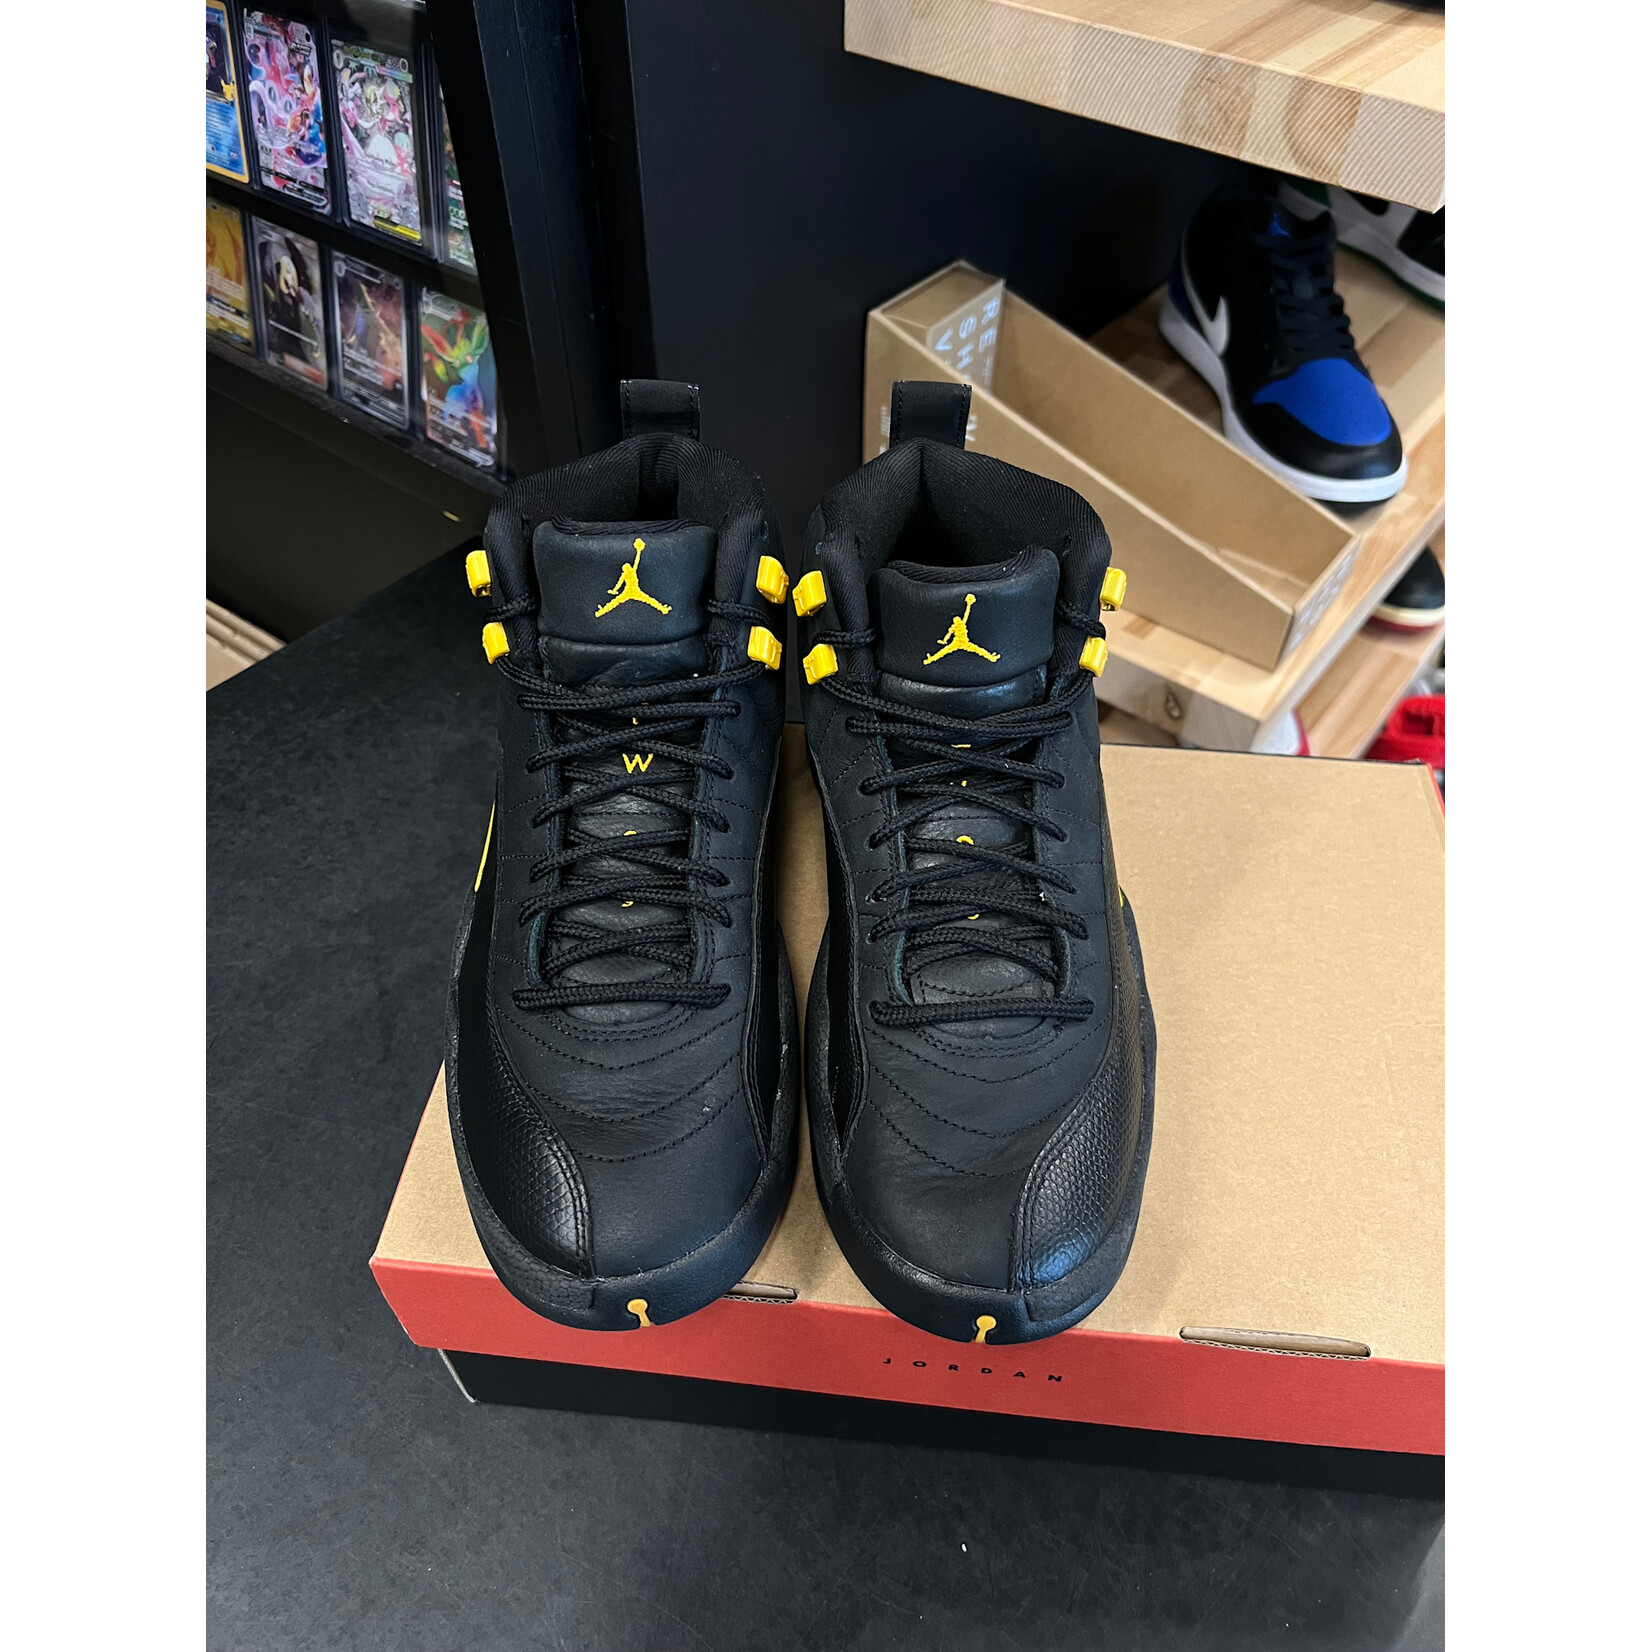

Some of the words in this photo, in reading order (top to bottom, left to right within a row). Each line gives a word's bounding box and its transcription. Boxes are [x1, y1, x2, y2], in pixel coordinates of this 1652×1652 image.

[957, 316, 977, 379] SH
[979, 298, 998, 353] RE
[883, 1358, 1062, 1382] JORDAN
